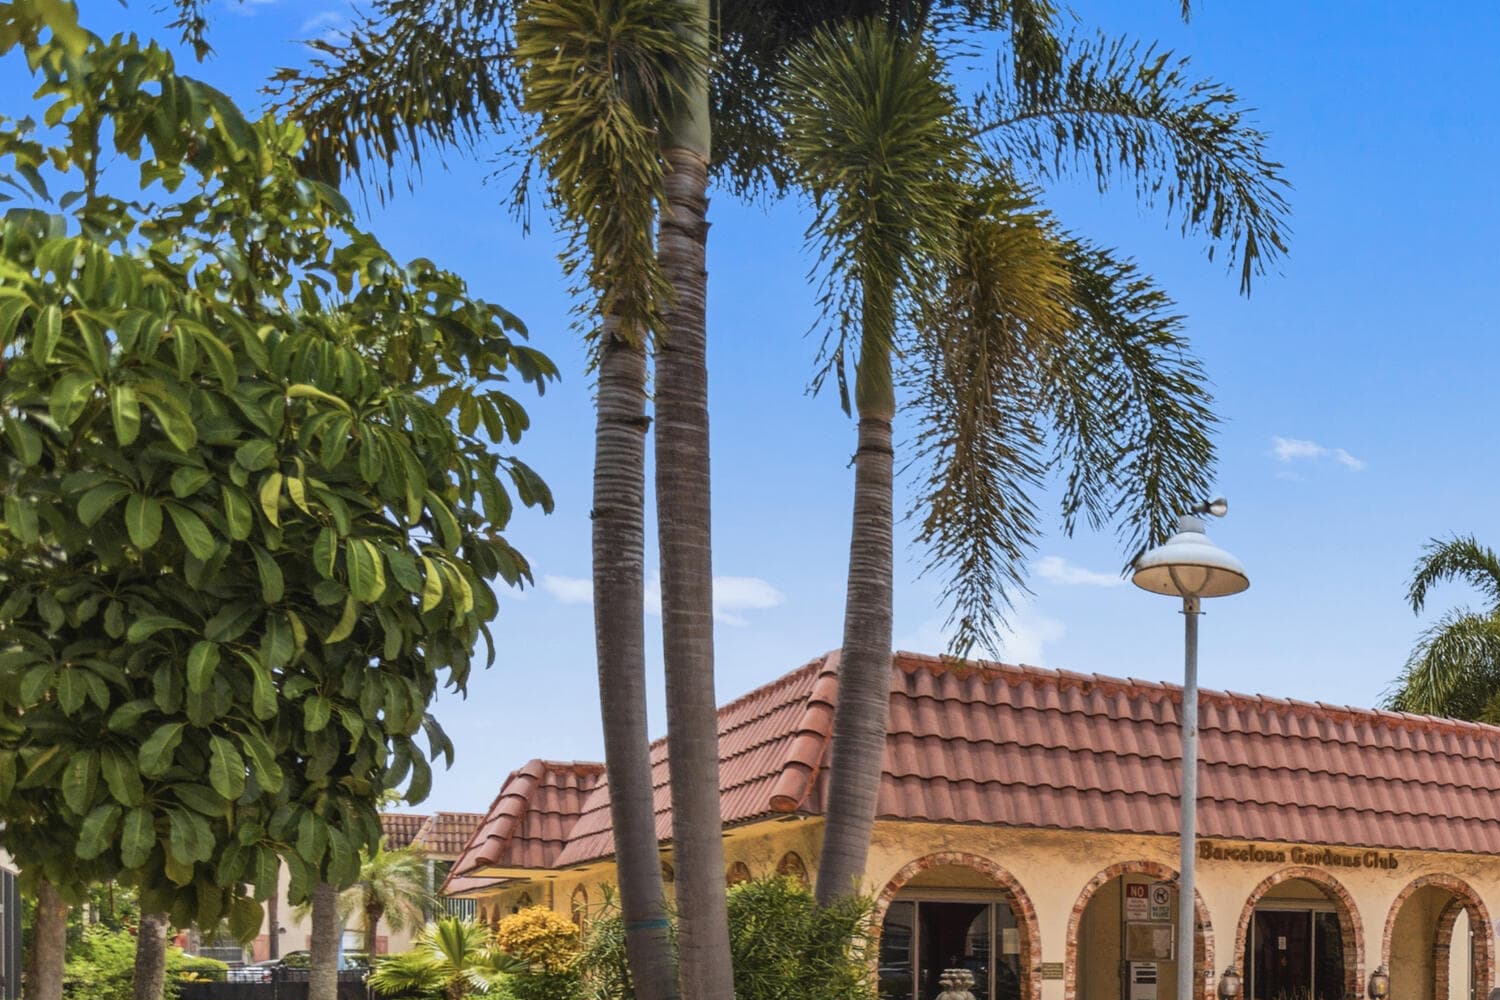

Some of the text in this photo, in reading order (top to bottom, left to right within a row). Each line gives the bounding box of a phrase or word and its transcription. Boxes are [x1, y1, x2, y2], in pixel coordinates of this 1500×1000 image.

[1199, 841, 1399, 869] Barcelona Gardens Club
[1130, 886, 1145, 898] NO
